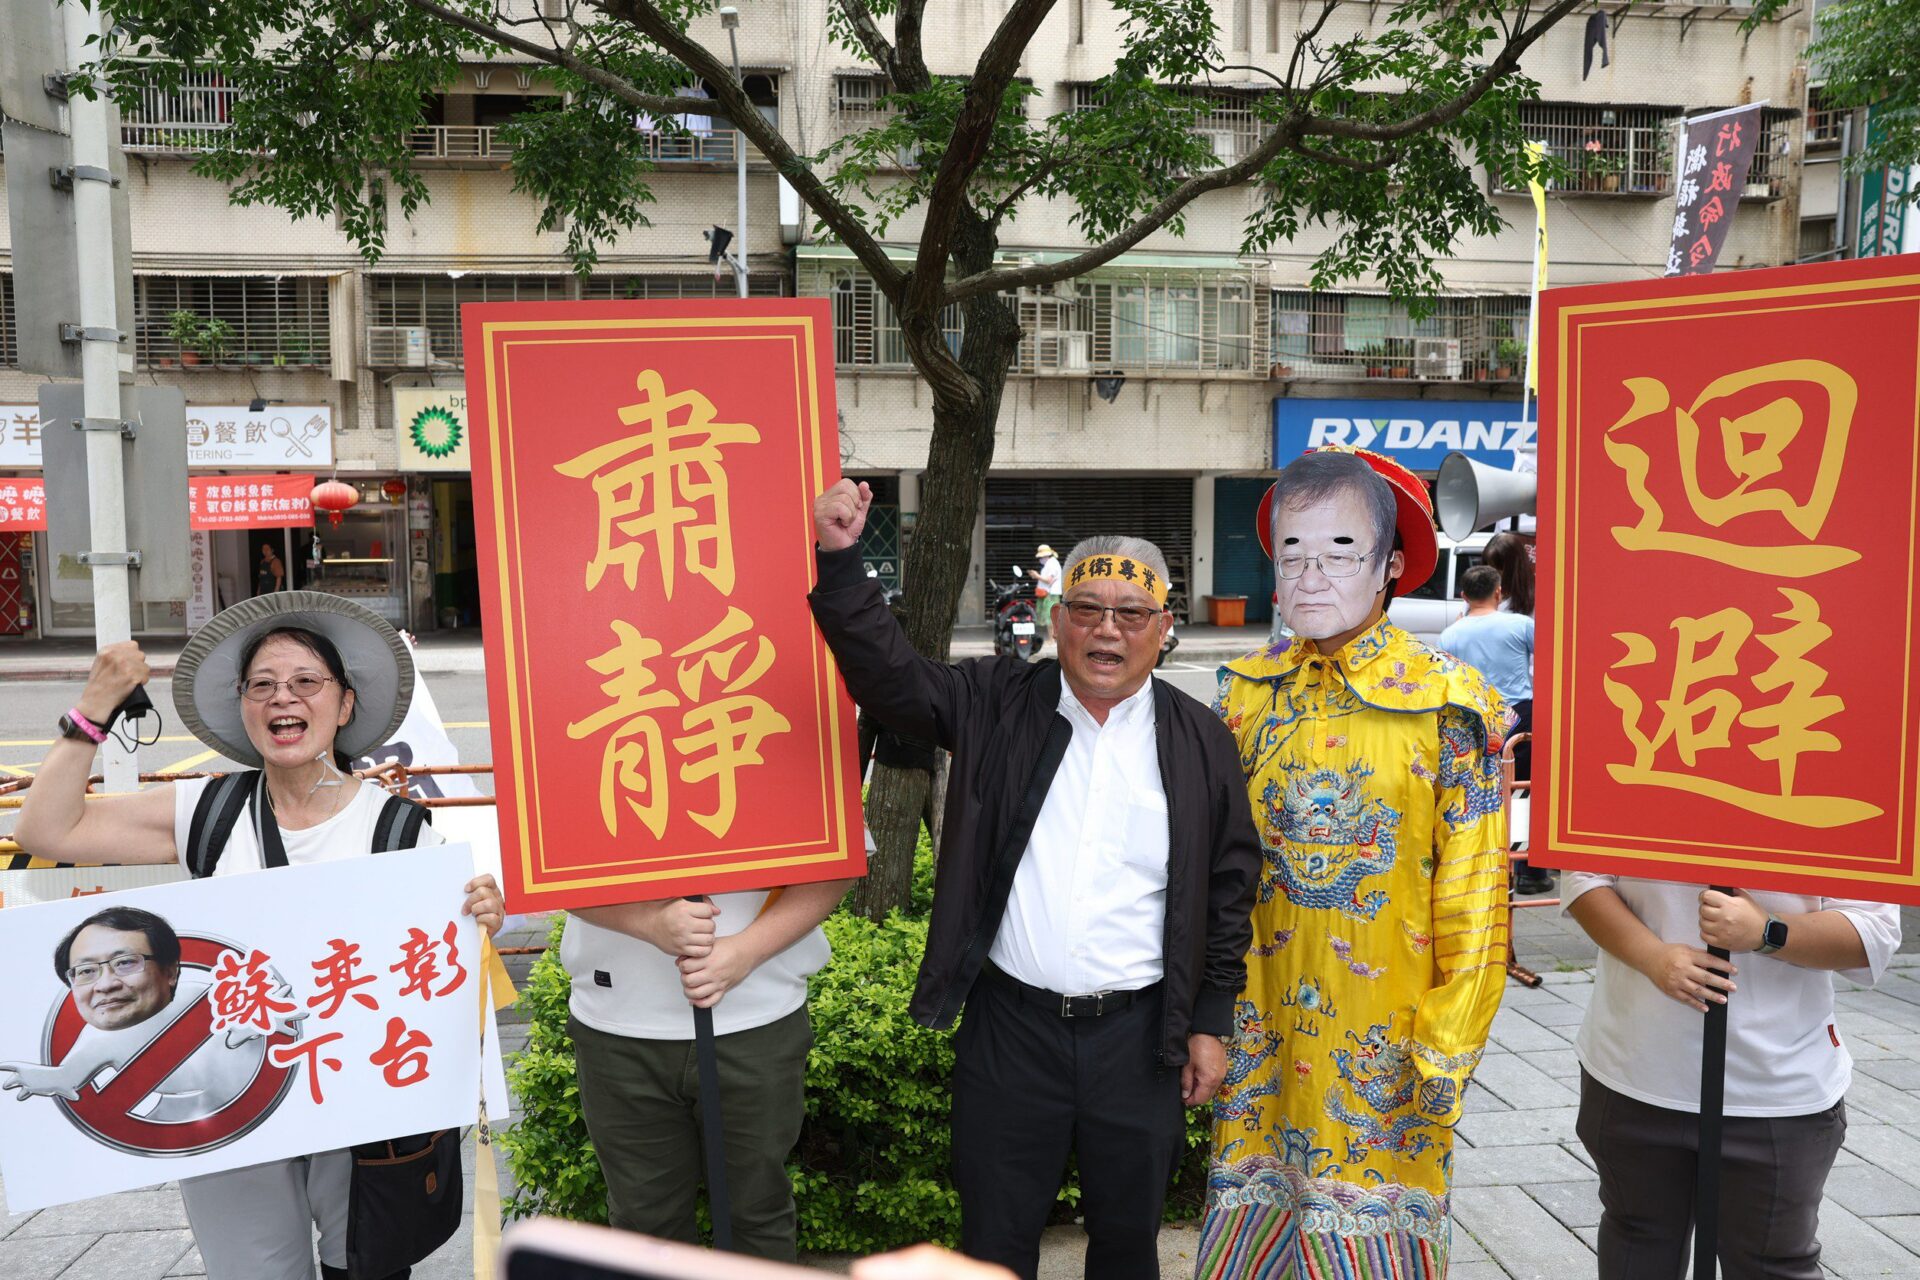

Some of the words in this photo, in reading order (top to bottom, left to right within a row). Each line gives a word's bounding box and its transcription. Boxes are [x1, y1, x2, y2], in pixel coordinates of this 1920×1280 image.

[1307, 417, 1537, 450] RYDANZ
[553, 368, 791, 840] 肅靜
[1071, 558, 1156, 593] 捍衛專業
[1603, 359, 1884, 828] 迴避
[216, 921, 467, 1031] 蘇奕彰
[273, 1017, 433, 1105] 下台
